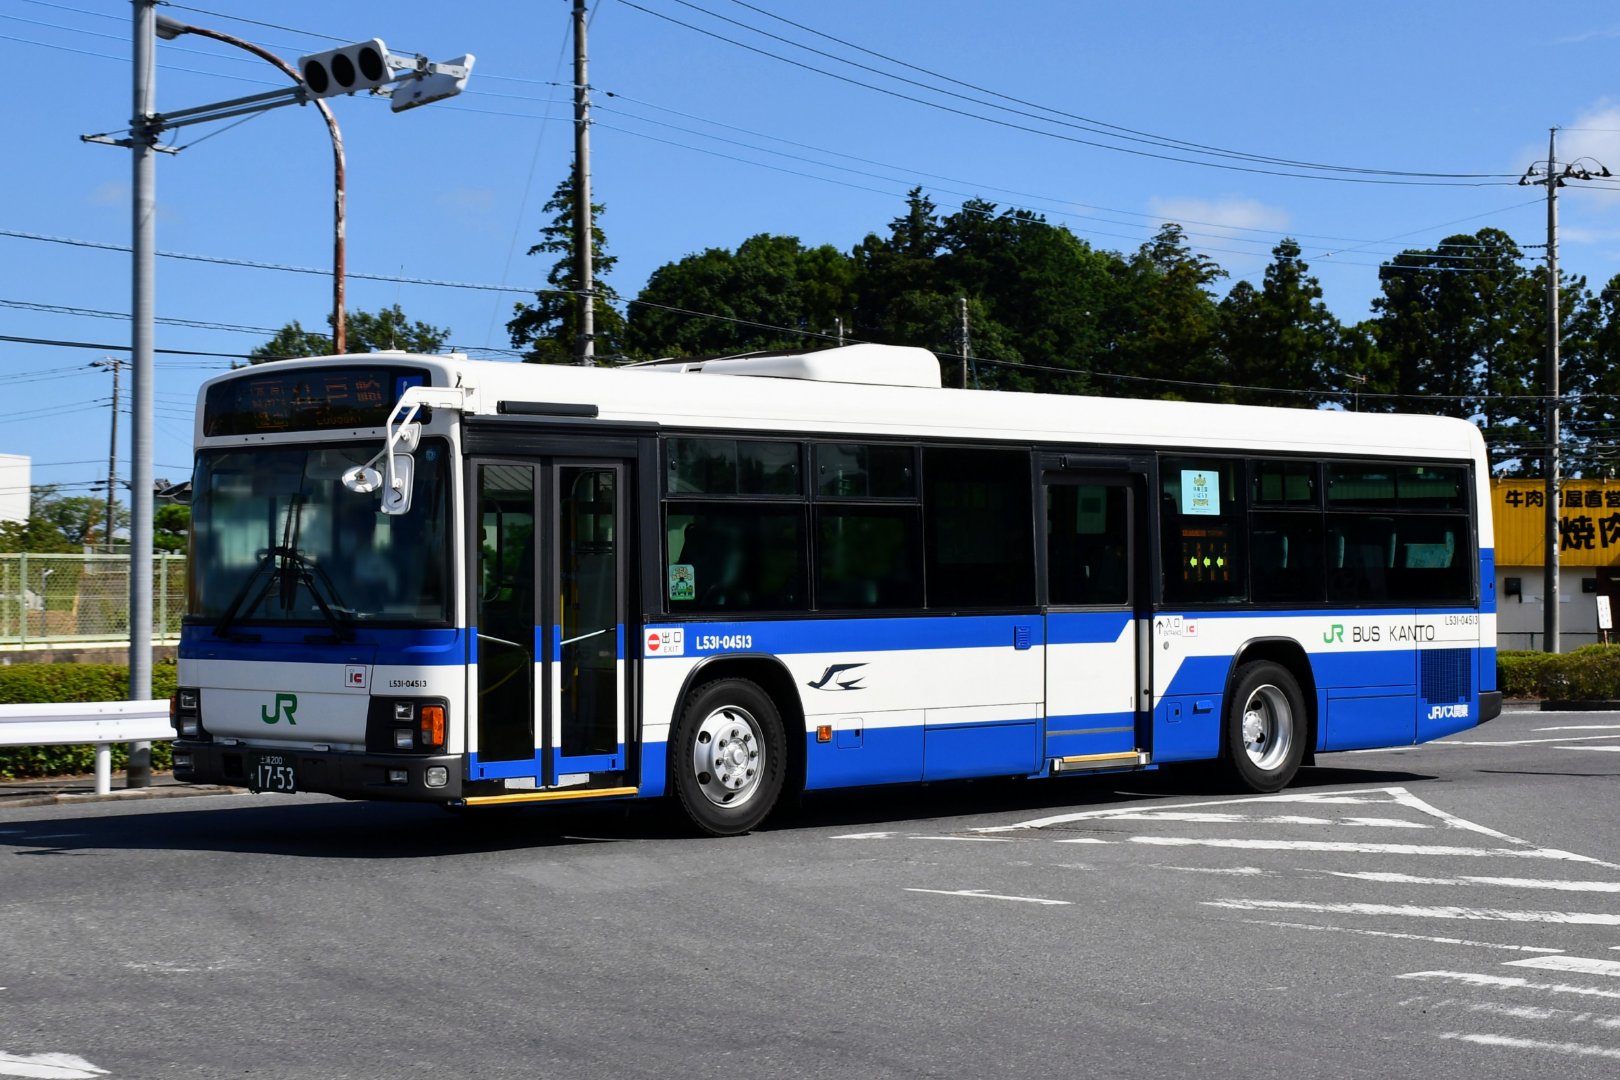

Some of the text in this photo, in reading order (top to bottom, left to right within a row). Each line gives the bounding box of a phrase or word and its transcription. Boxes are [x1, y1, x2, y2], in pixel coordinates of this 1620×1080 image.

[1505, 490, 1620, 508] 牛肉屋直営
[1166, 618, 1180, 628] 入口
[1445, 616, 1478, 626] L531-04513
[662, 632, 681, 644] 出口
[1323, 624, 1435, 643] JR BUS KANTO
[696, 635, 752, 649] L531-04513
[389, 680, 427, 688] L531-04513
[262, 693, 297, 725] JR
